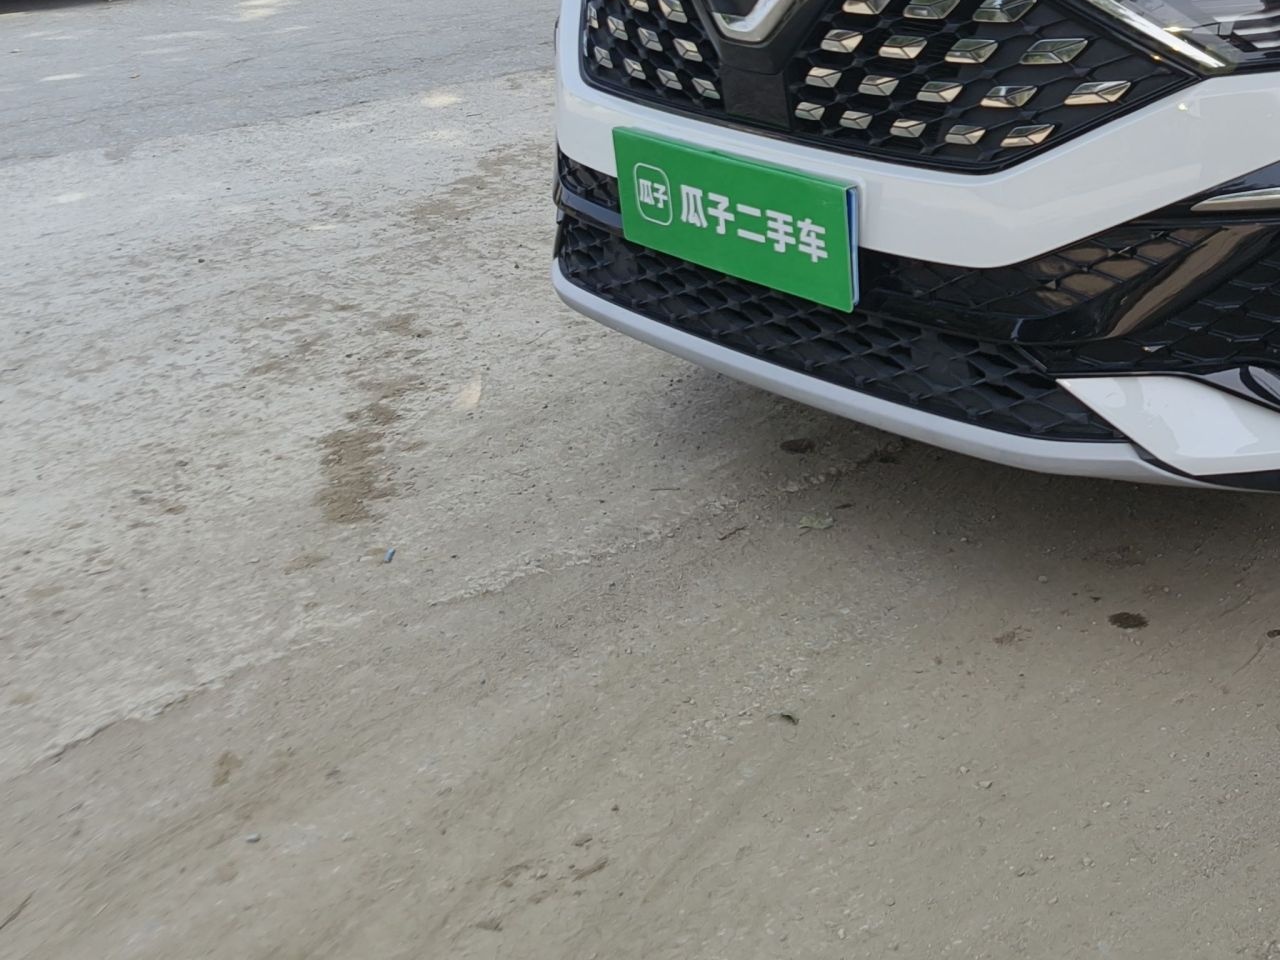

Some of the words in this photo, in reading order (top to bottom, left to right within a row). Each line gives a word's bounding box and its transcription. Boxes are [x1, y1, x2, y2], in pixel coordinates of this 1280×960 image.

[638, 178, 668, 209] 瓜子
[679, 184, 828, 263] 瓜子二手车
